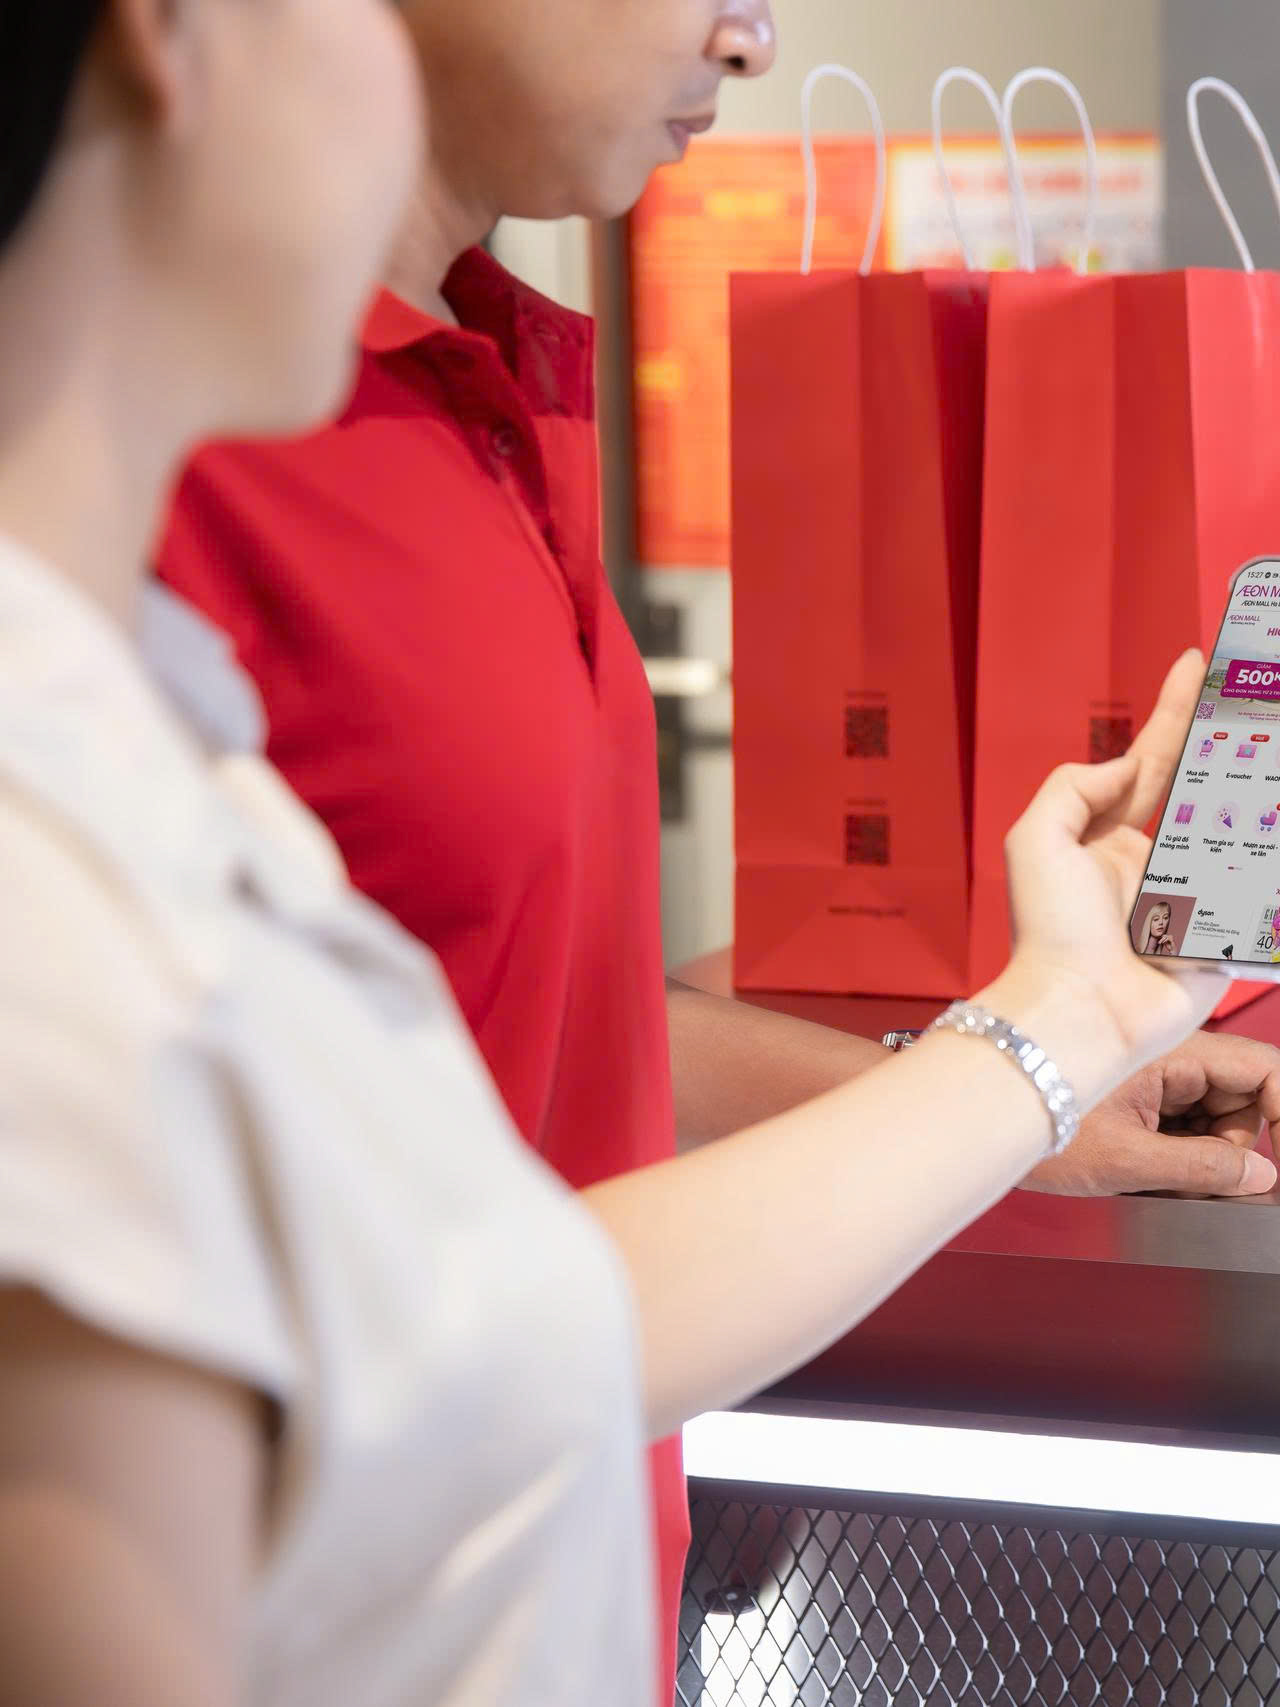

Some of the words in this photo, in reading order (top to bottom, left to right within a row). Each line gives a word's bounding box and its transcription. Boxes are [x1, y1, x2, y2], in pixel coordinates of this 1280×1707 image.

[1202, 838, 1219, 846] Tham
[1145, 873, 1173, 885] Khuyến
[1174, 874, 1188, 885] mãi
[1197, 908, 1214, 917] dyson
